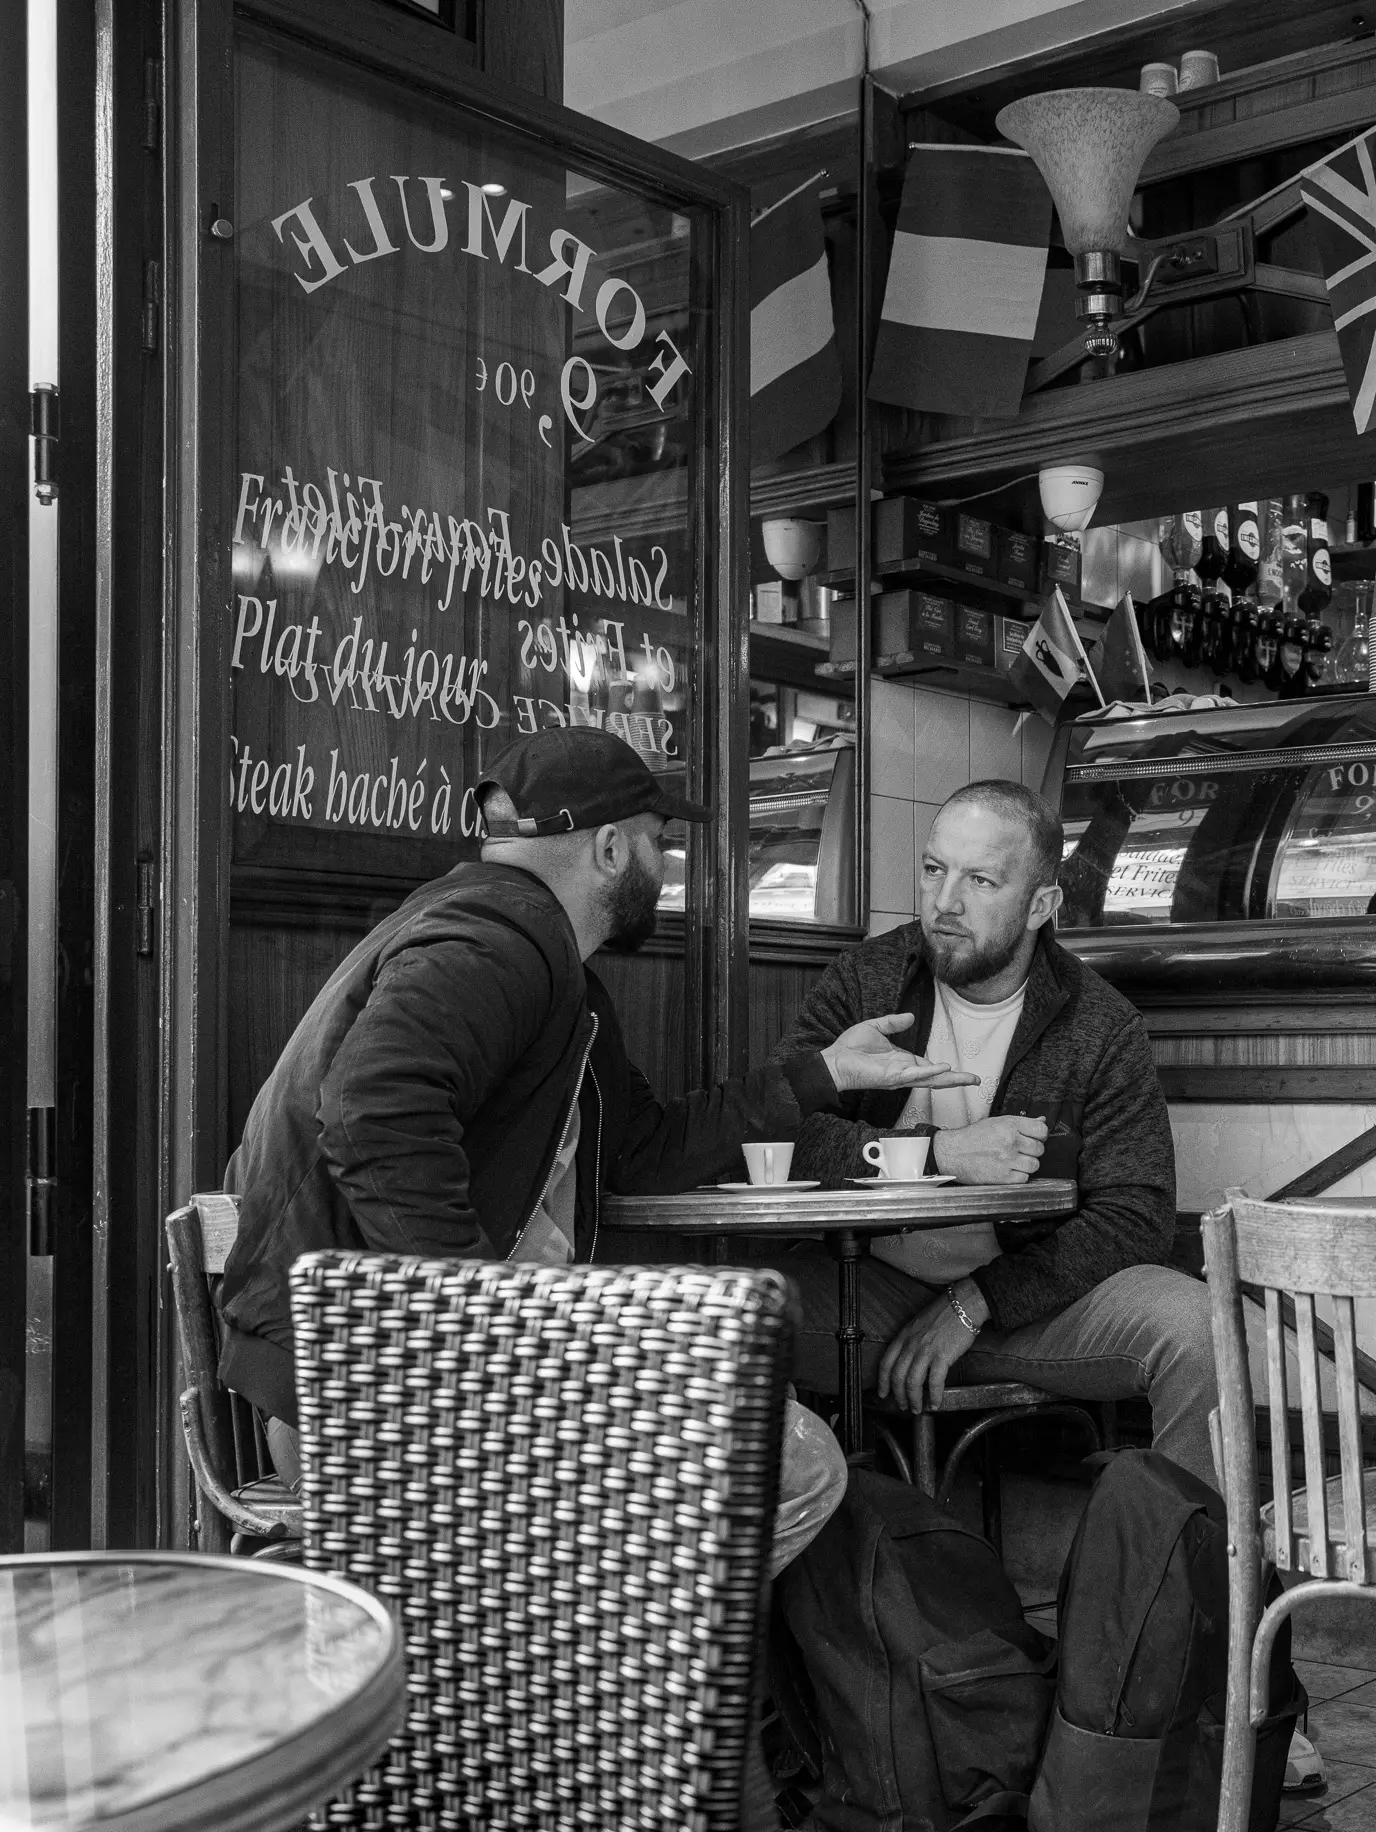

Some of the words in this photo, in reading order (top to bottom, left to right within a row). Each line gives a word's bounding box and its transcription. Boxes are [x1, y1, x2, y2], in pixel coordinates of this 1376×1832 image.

[231, 594, 322, 680] Plat
[333, 615, 388, 692] du
[393, 629, 488, 718] jour
[230, 735, 314, 820] teak
[325, 746, 427, 832] haché
[431, 765, 452, 835] à
